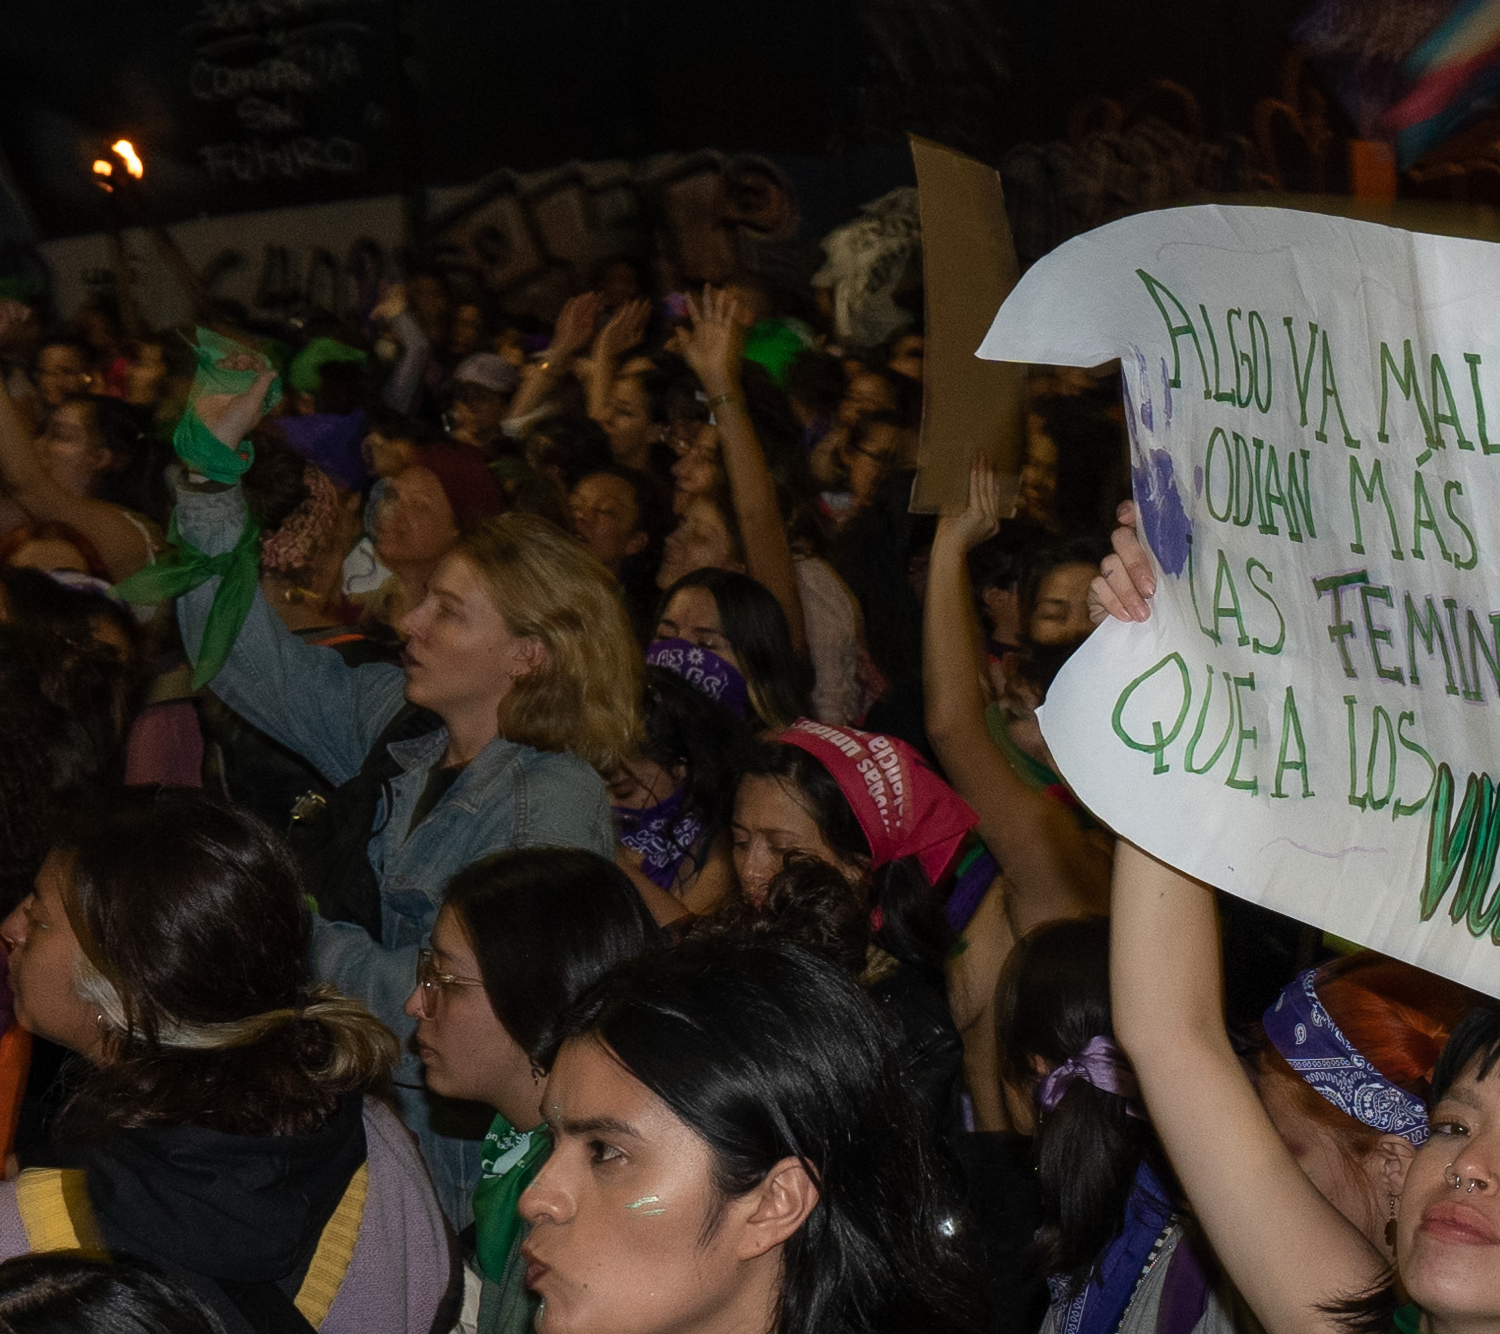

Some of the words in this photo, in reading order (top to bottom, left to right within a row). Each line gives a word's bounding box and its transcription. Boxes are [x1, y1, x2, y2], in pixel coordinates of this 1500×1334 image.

[1134, 267, 1274, 414] ALGO
[1282, 315, 1361, 450] VA
[1203, 426, 1320, 543] ODIAN
[1348, 447, 1479, 572] MÁS
[1184, 533, 1286, 656] LAS
[1110, 651, 1259, 798] QUE
[1269, 685, 1316, 800] A
[1341, 693, 1438, 820] LOS
